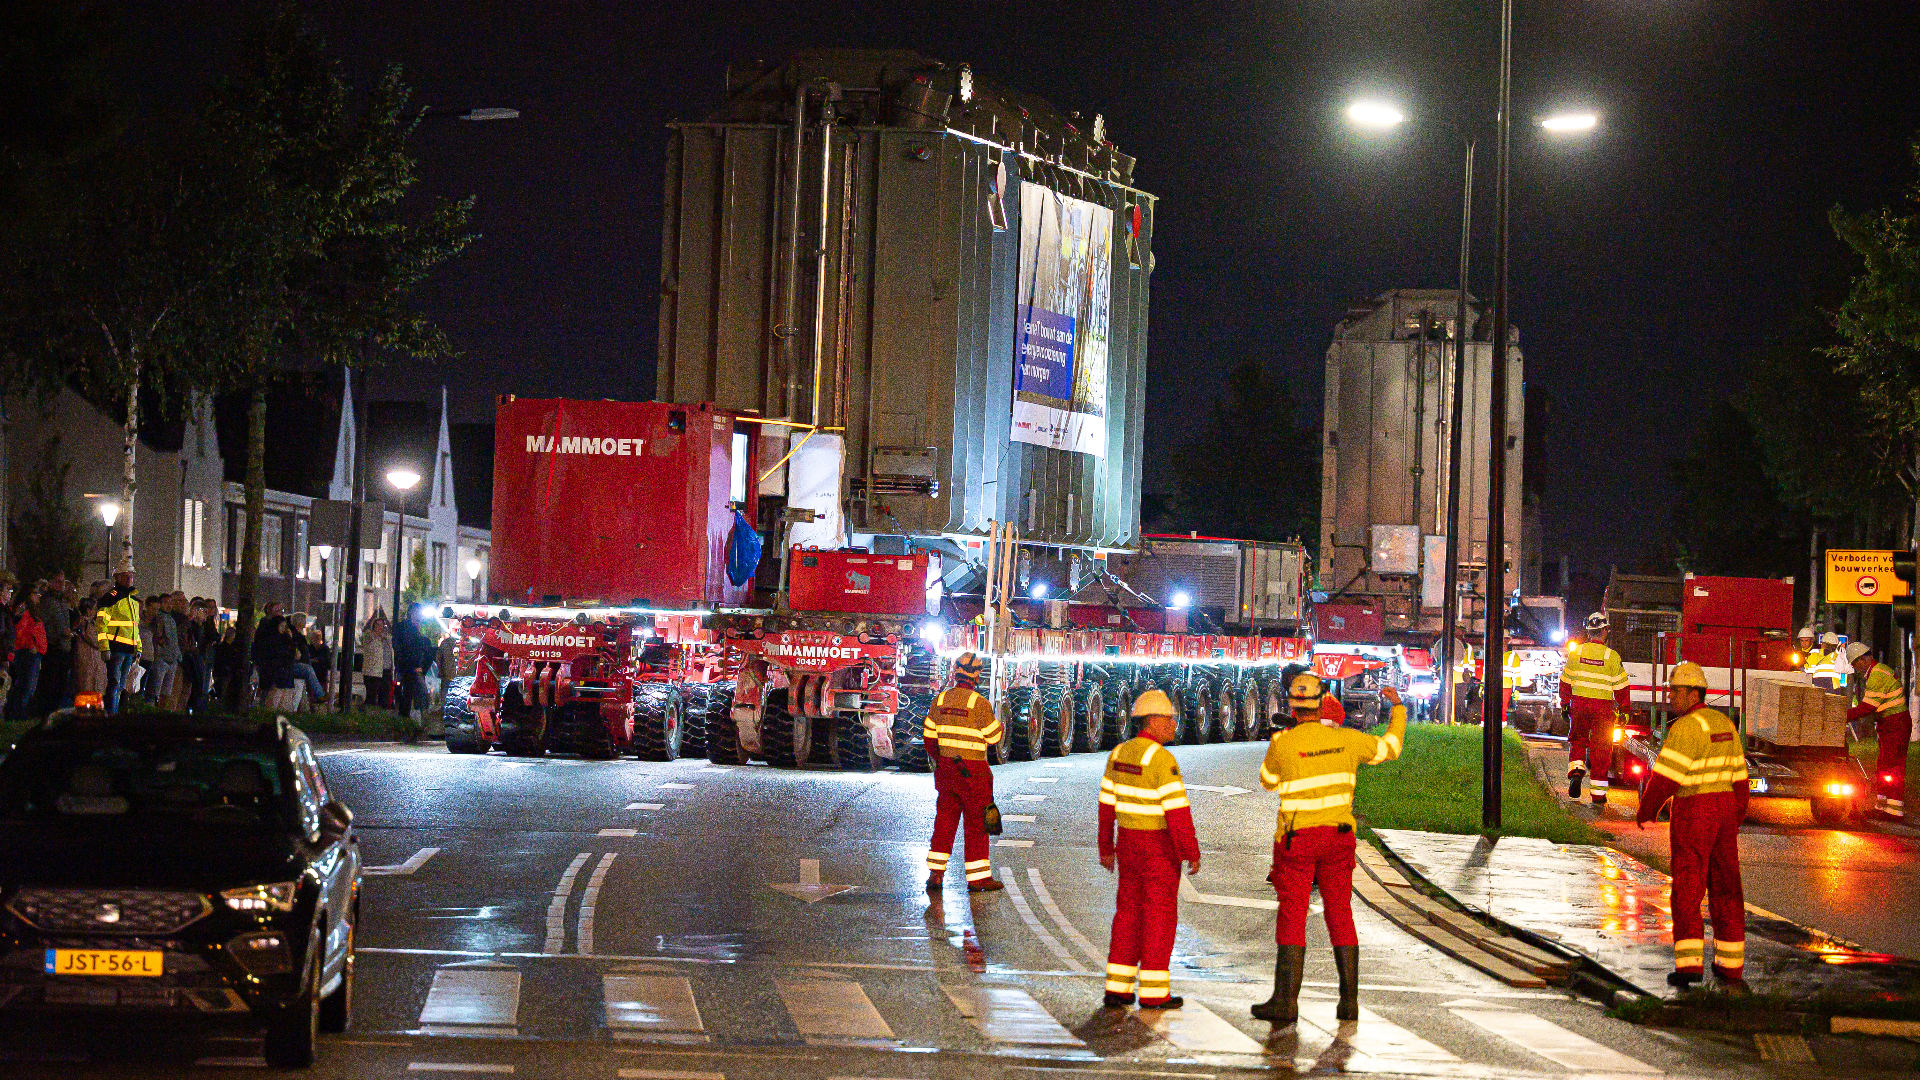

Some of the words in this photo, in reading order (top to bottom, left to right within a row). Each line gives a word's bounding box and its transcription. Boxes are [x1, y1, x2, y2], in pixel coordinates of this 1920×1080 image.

[1040, 322, 1056, 341] bouwt
[1056, 330, 1066, 343] aan
[1066, 329, 1073, 345] de
[526, 435, 643, 456] MAMMOET
[1831, 554, 1879, 562] Verboden
[1834, 565, 1895, 573] bouwverkee
[512, 633, 597, 648] MAMMOET
[529, 650, 562, 658] 301139
[779, 644, 862, 660] MAMMOET
[64, 953, 152, 972] JST-56-L
